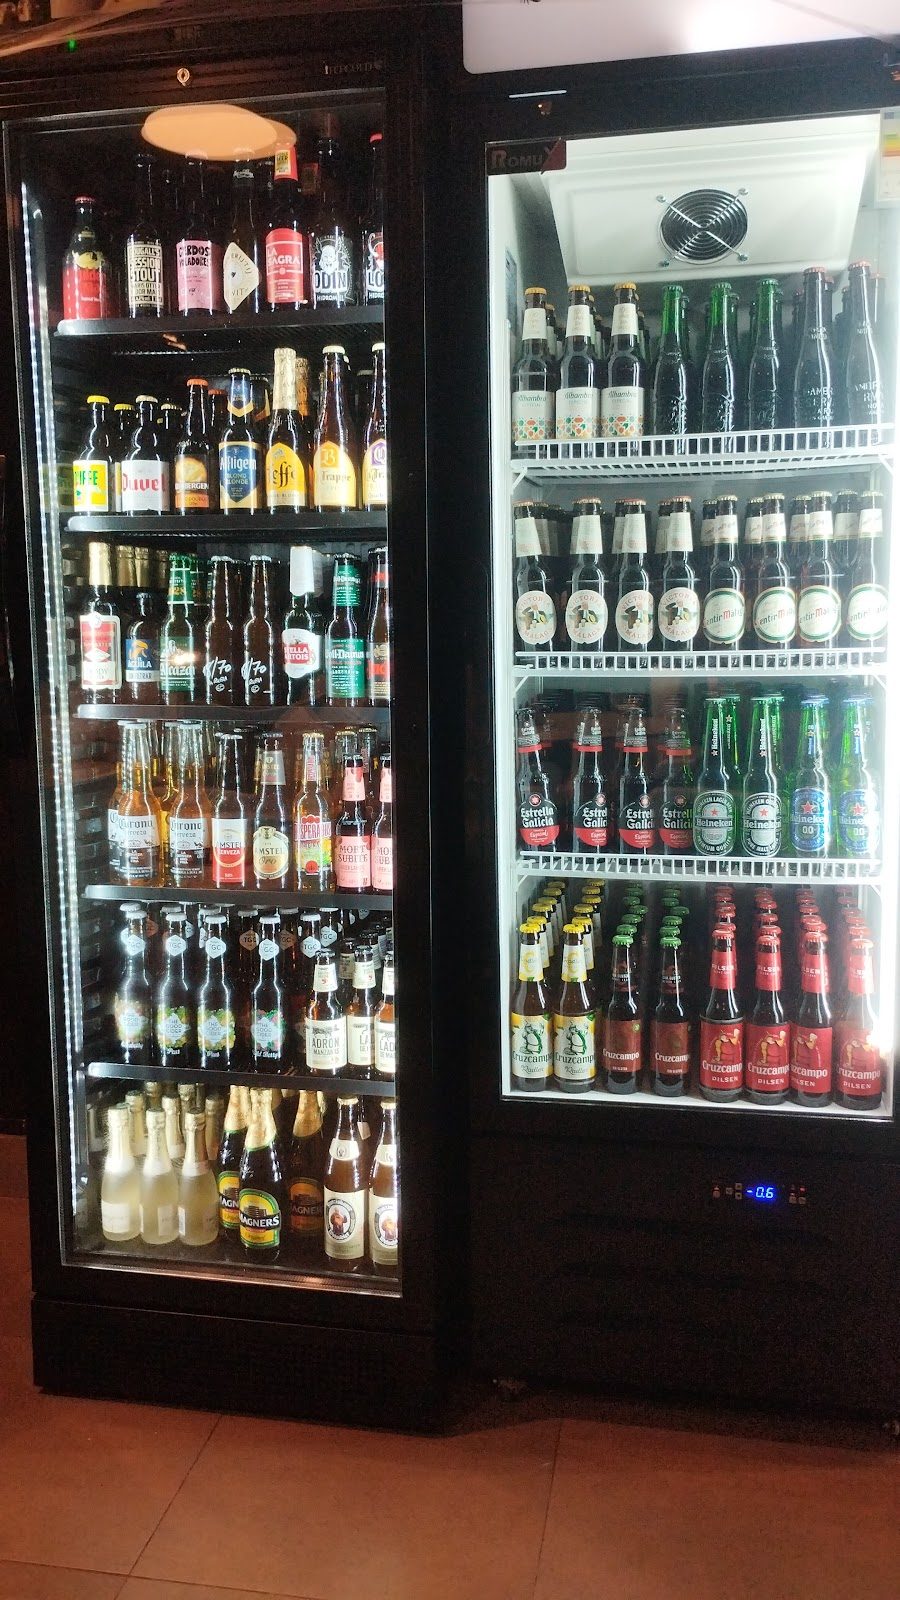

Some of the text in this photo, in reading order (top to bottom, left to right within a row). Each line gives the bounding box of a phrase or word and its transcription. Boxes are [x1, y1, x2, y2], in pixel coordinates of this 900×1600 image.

[711, 718, 719, 750] Heineken
[520, 807, 555, 818] Estrella
[522, 816, 555, 828] Galicia
[696, 818, 733, 828] Heineken
[743, 819, 782, 829] Heineken
[602, 1048, 640, 1061] Cruzcampo
[712, 1075, 739, 1083] PILSEN
[746, 1186, 775, 1199] -0.6
[239, 1212, 280, 1227] MAGNERS
